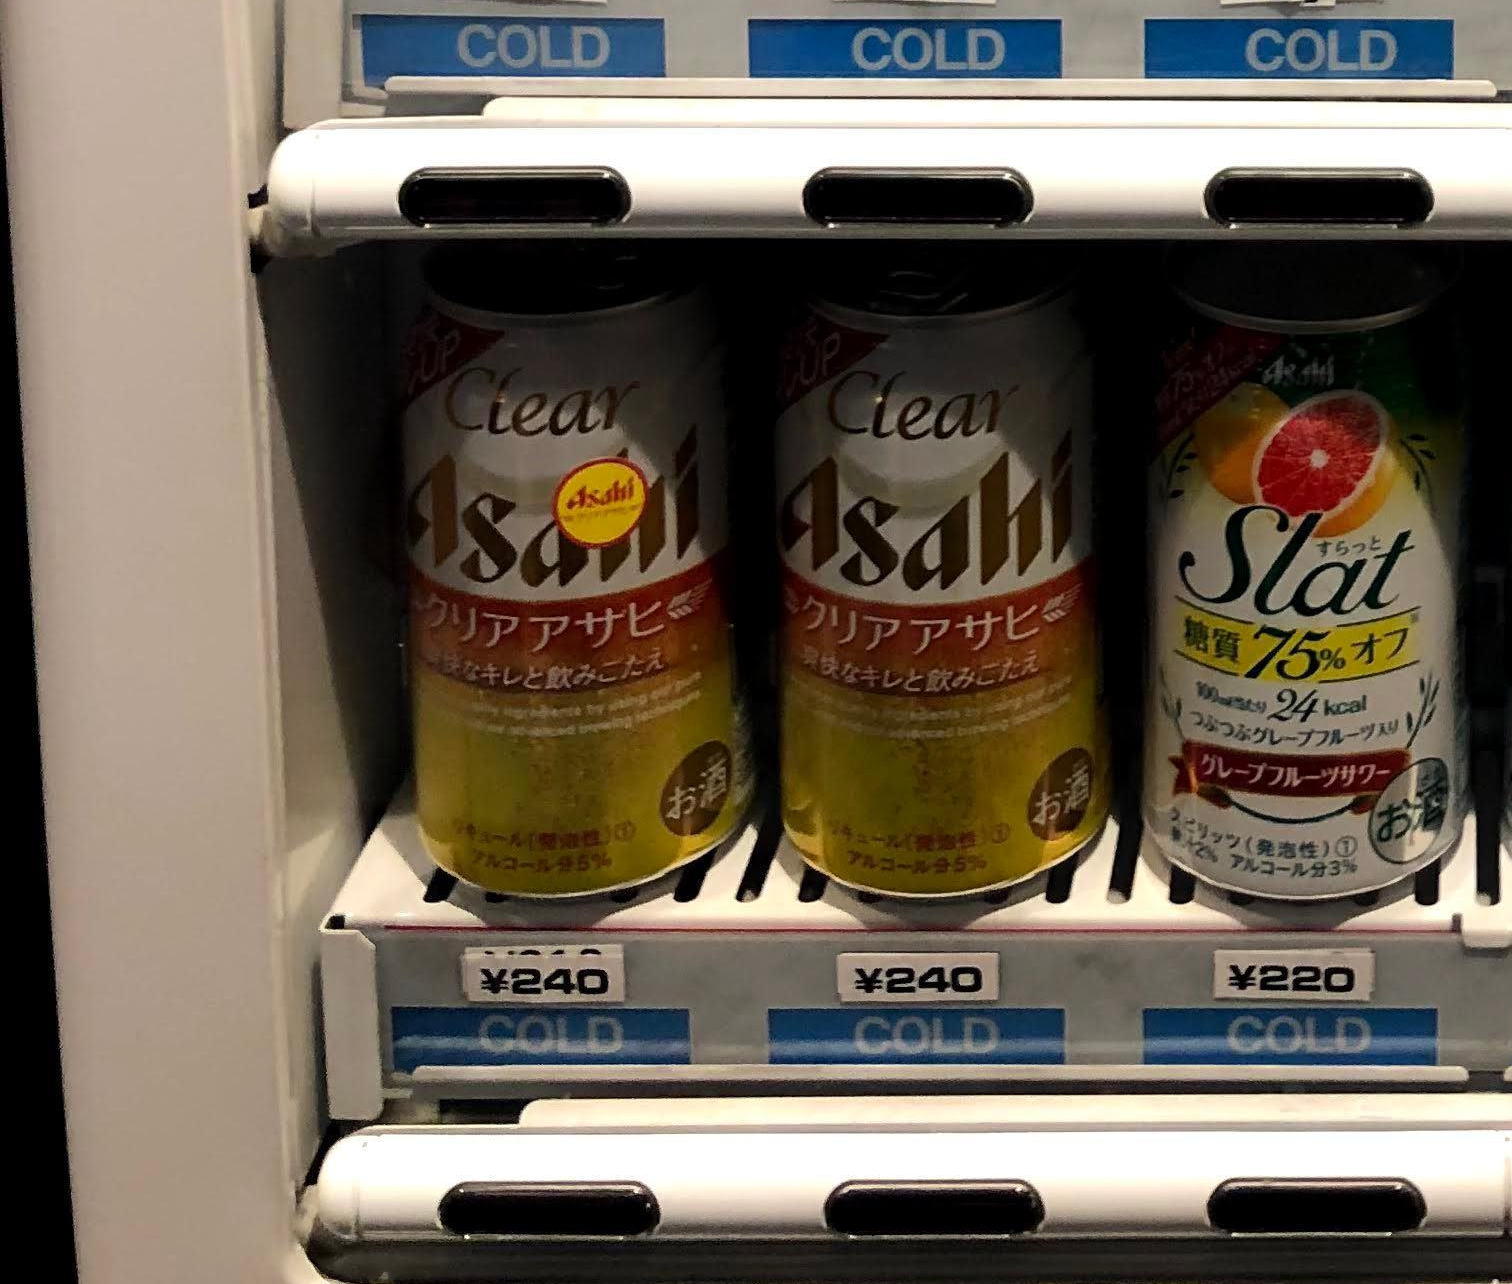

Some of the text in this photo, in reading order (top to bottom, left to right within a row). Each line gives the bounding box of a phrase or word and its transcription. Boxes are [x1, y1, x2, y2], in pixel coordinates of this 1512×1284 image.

[457, 24, 610, 70] COLD
[852, 28, 1005, 72] COLD
[1245, 28, 1397, 73] COLD
[446, 367, 640, 436] Clear
[827, 370, 1019, 441] Clear
[566, 478, 635, 510] Asahi
[781, 429, 1072, 591] Asahi
[1178, 504, 1415, 617] Slat
[1267, 687, 1367, 723] 24 kcal
[481, 967, 610, 996] ¥240
[855, 966, 983, 994] ¥240
[1228, 963, 1356, 994] ¥220
[478, 1016, 625, 1056] COLD
[854, 1017, 999, 1055] COLD
[1226, 1016, 1373, 1056] COLD
